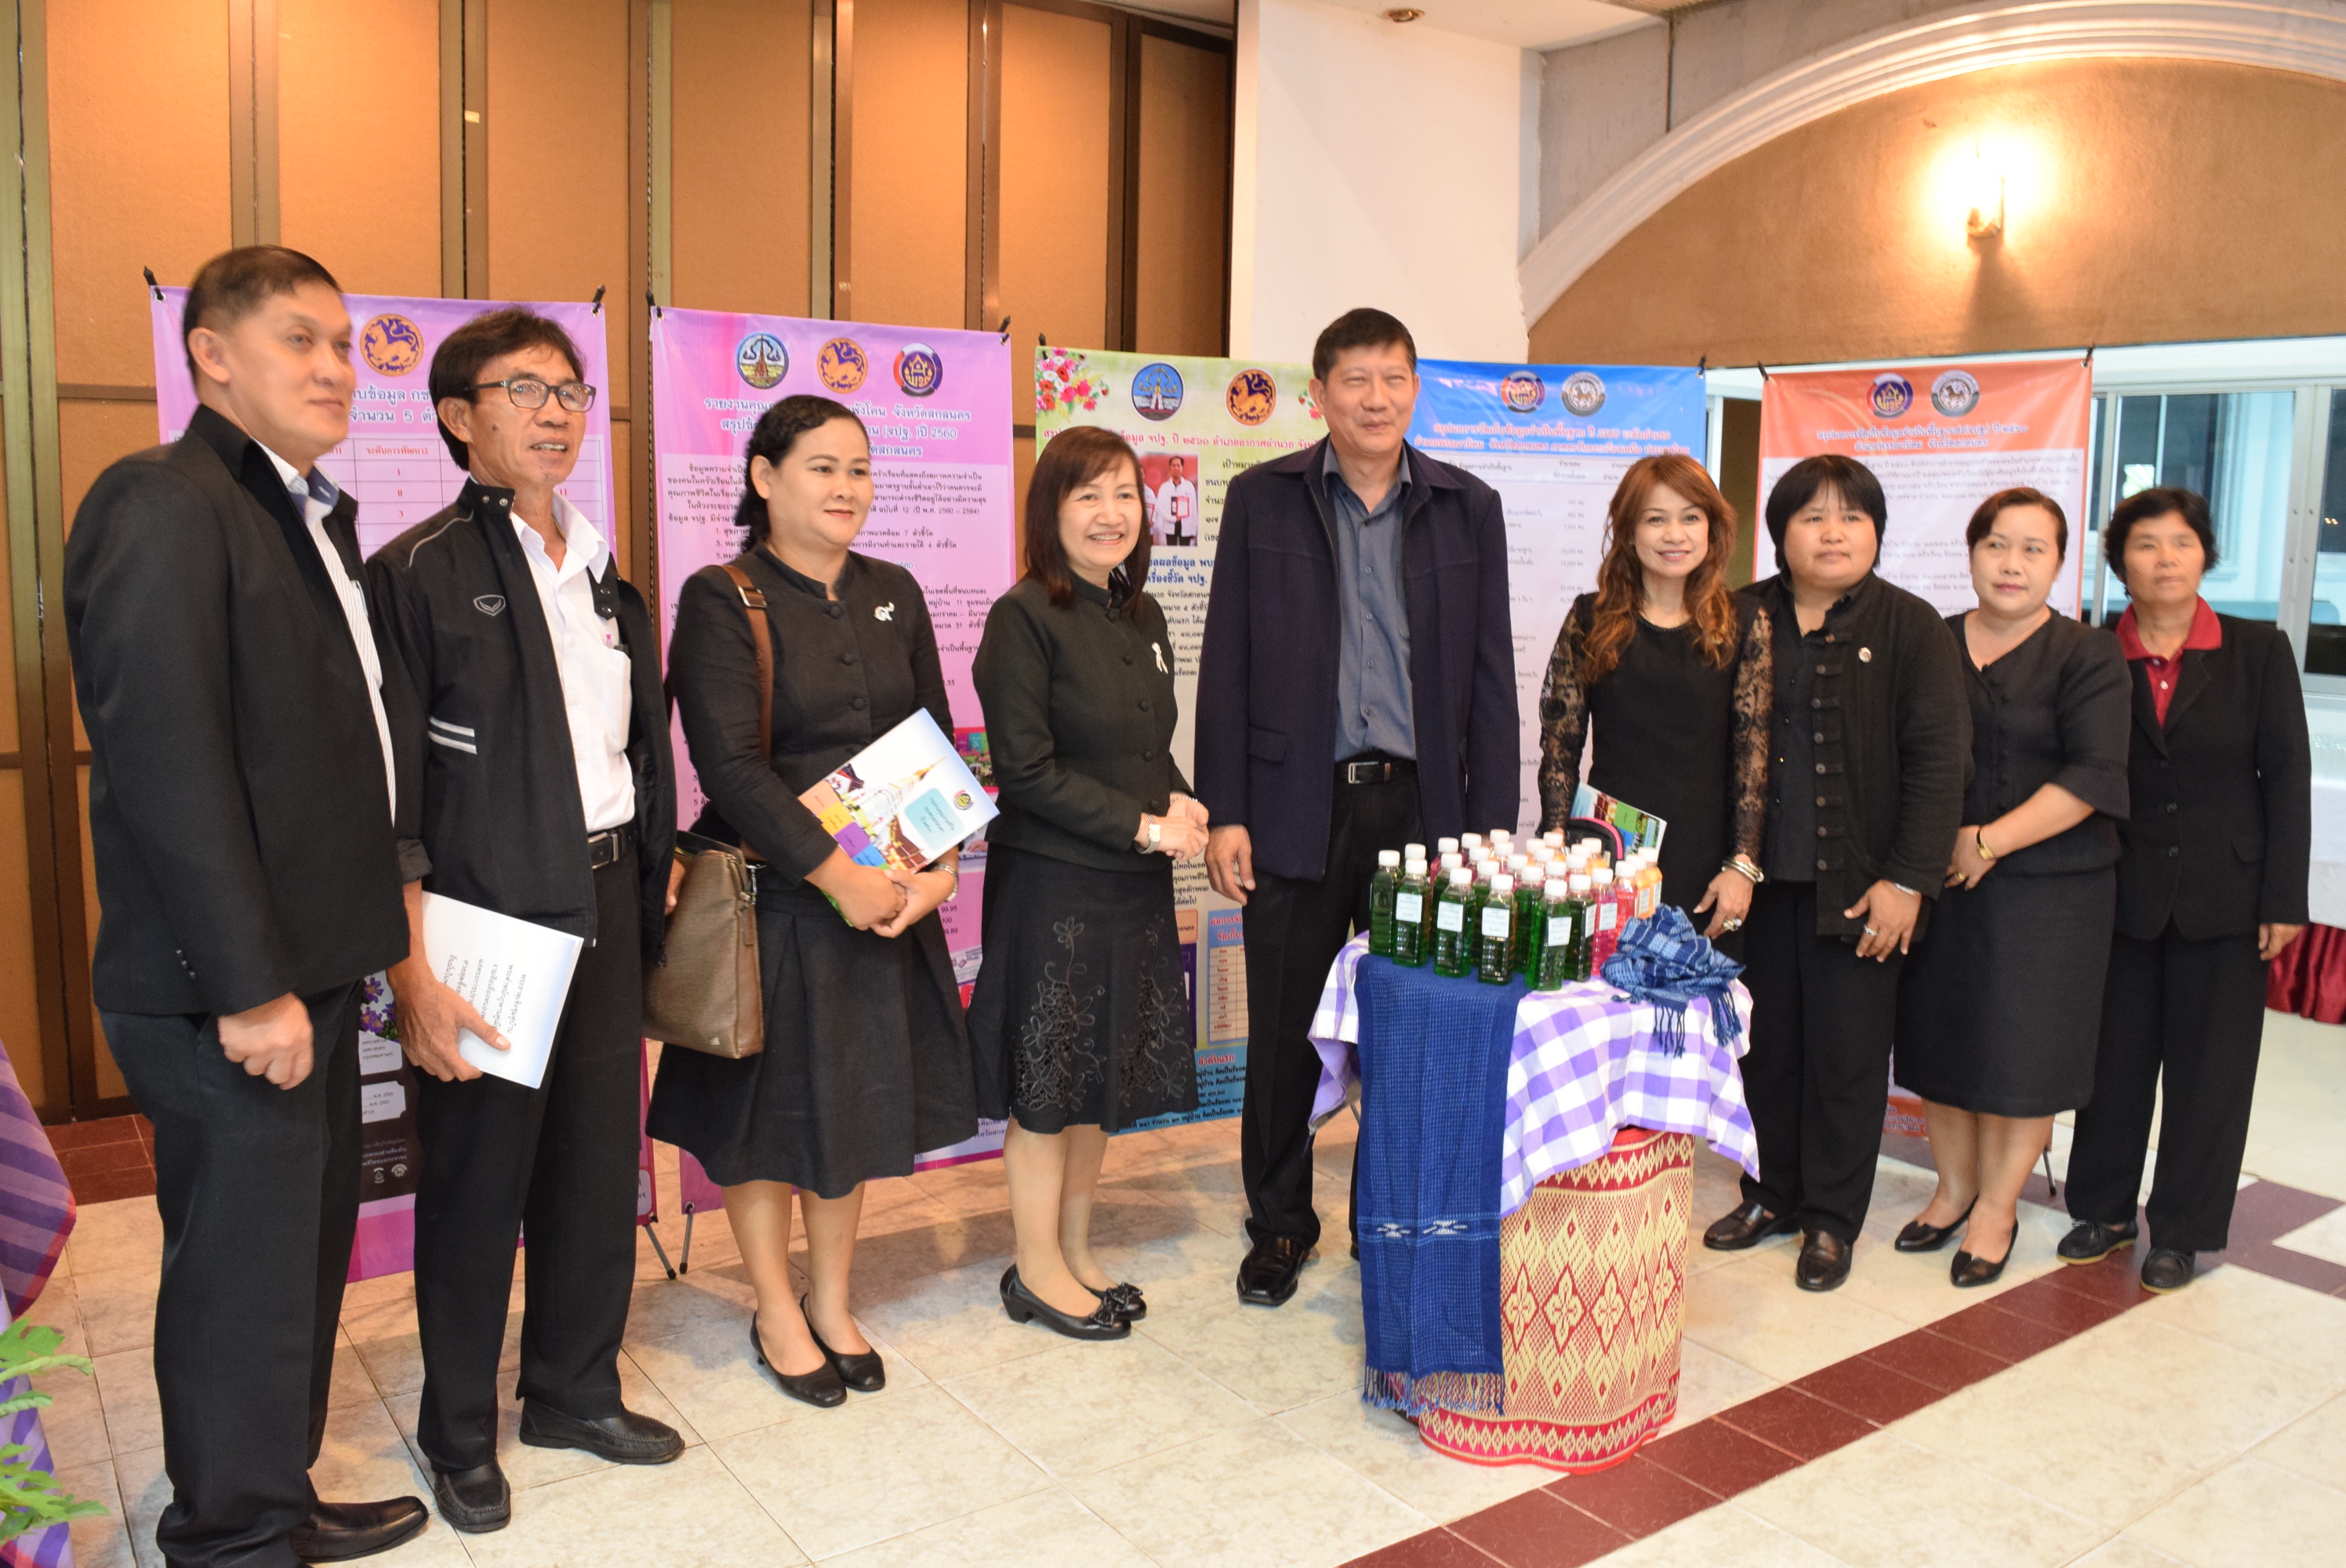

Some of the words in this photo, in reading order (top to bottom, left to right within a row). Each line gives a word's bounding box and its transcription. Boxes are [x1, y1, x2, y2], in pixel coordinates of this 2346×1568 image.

[405, 411, 412, 422] 5
[893, 403, 971, 421] จังหวัดสกลนคร
[931, 428, 957, 440] 2560
[1149, 433, 1168, 446] จปฐ.
[1173, 433, 1179, 445] ปี
[1182, 437, 1208, 446] ๒๕๖๐
[1213, 435, 1294, 449] อำเภออากาศอำนวย
